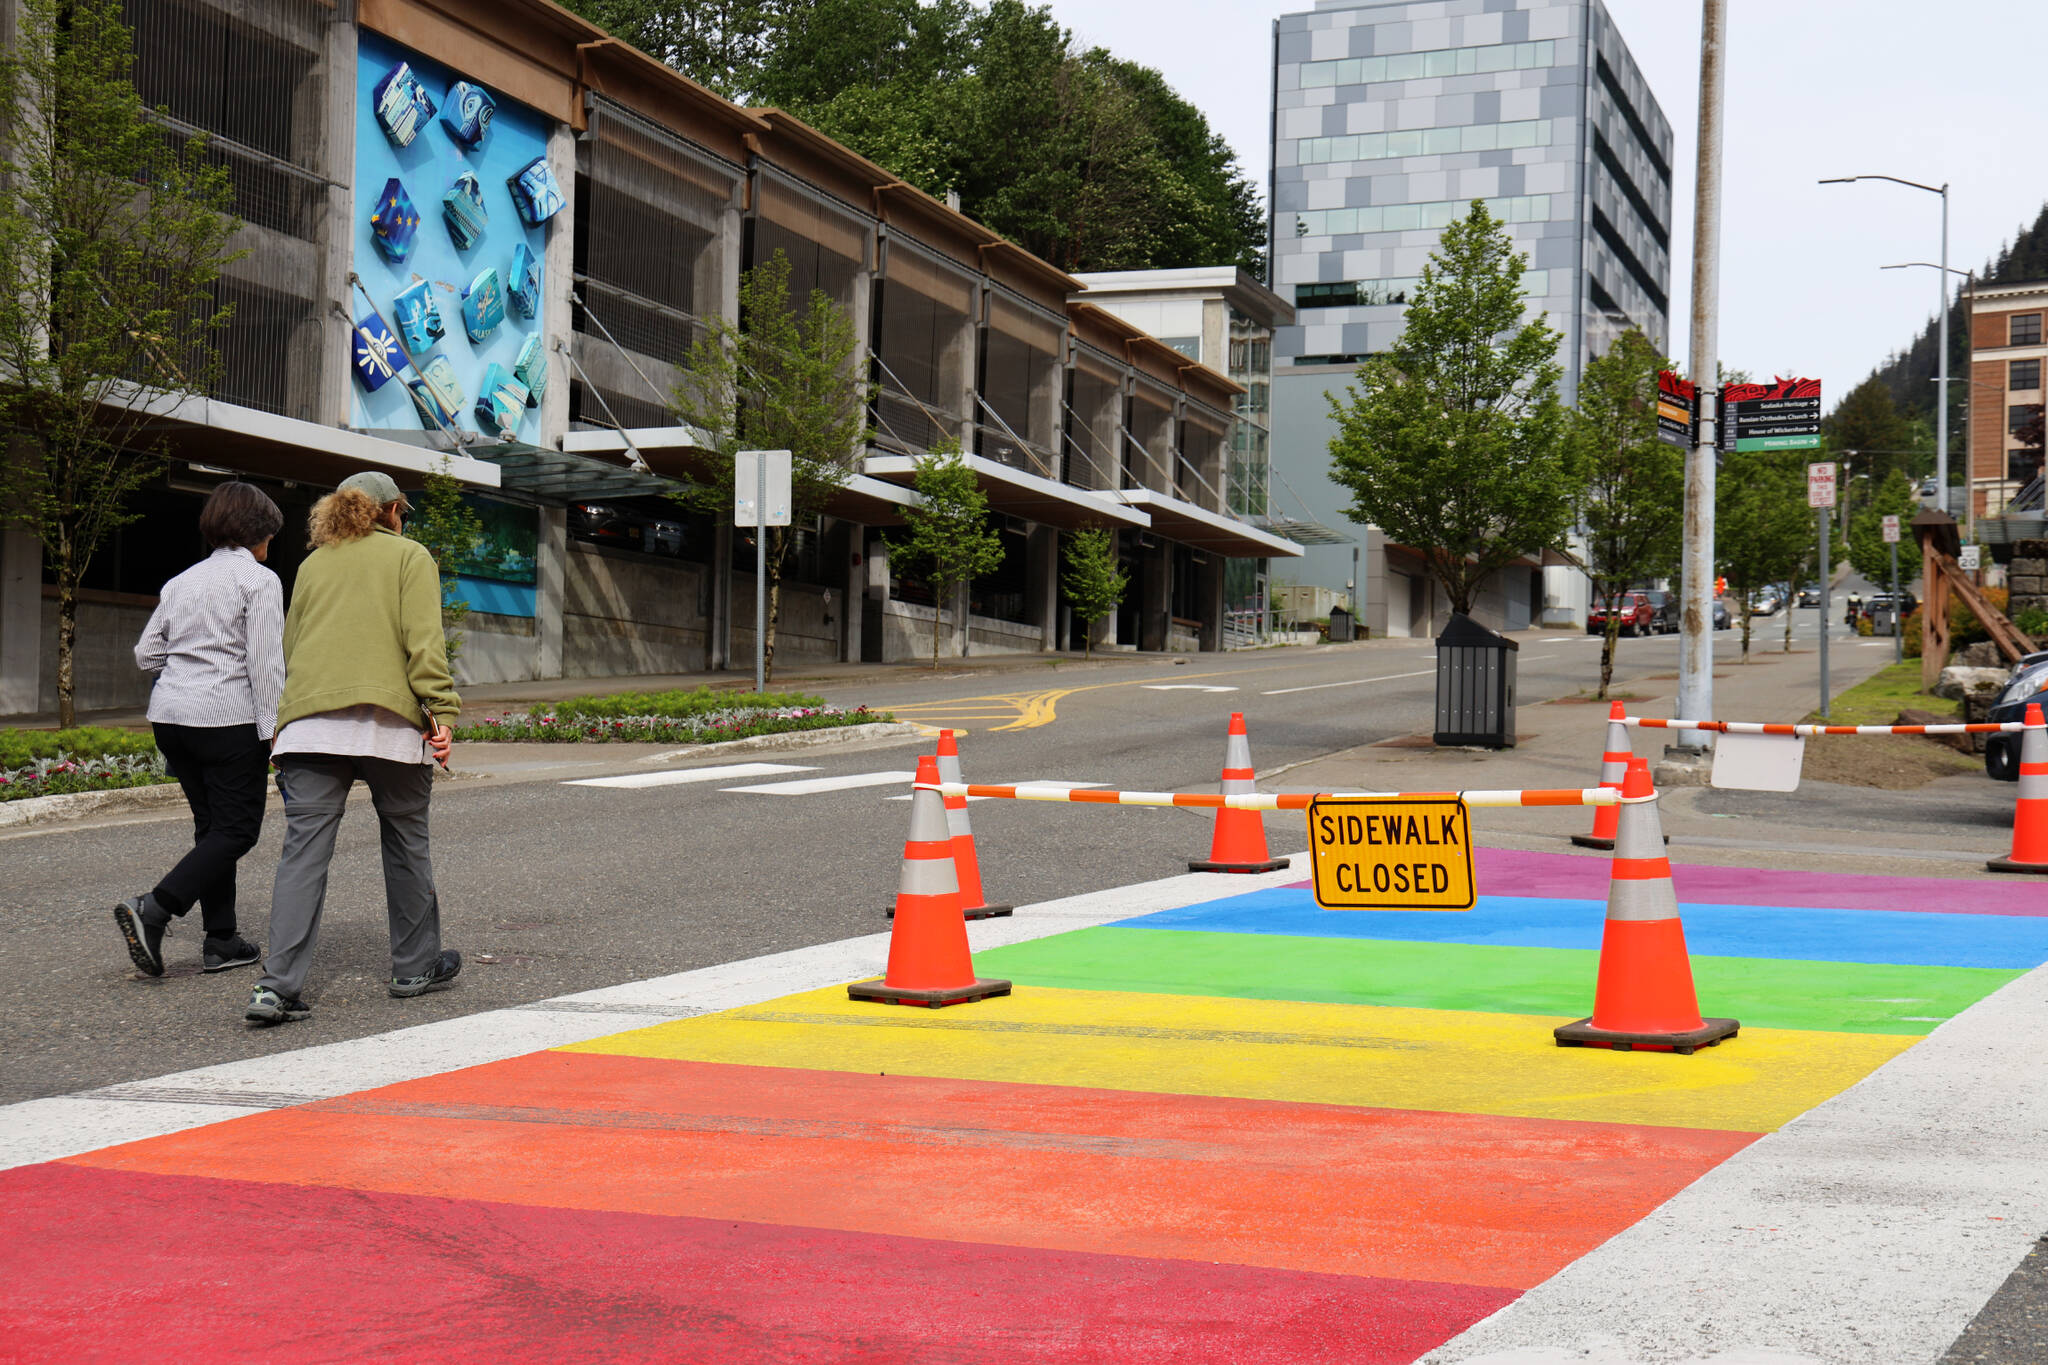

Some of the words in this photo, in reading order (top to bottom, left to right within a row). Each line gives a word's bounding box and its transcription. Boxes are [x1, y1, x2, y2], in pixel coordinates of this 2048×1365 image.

[1760, 414, 1787, 422] Orthodox
[1960, 558, 1977, 568] 20
[1320, 815, 1459, 846] SIDEWALK
[1336, 863, 1449, 894] CLOSED
